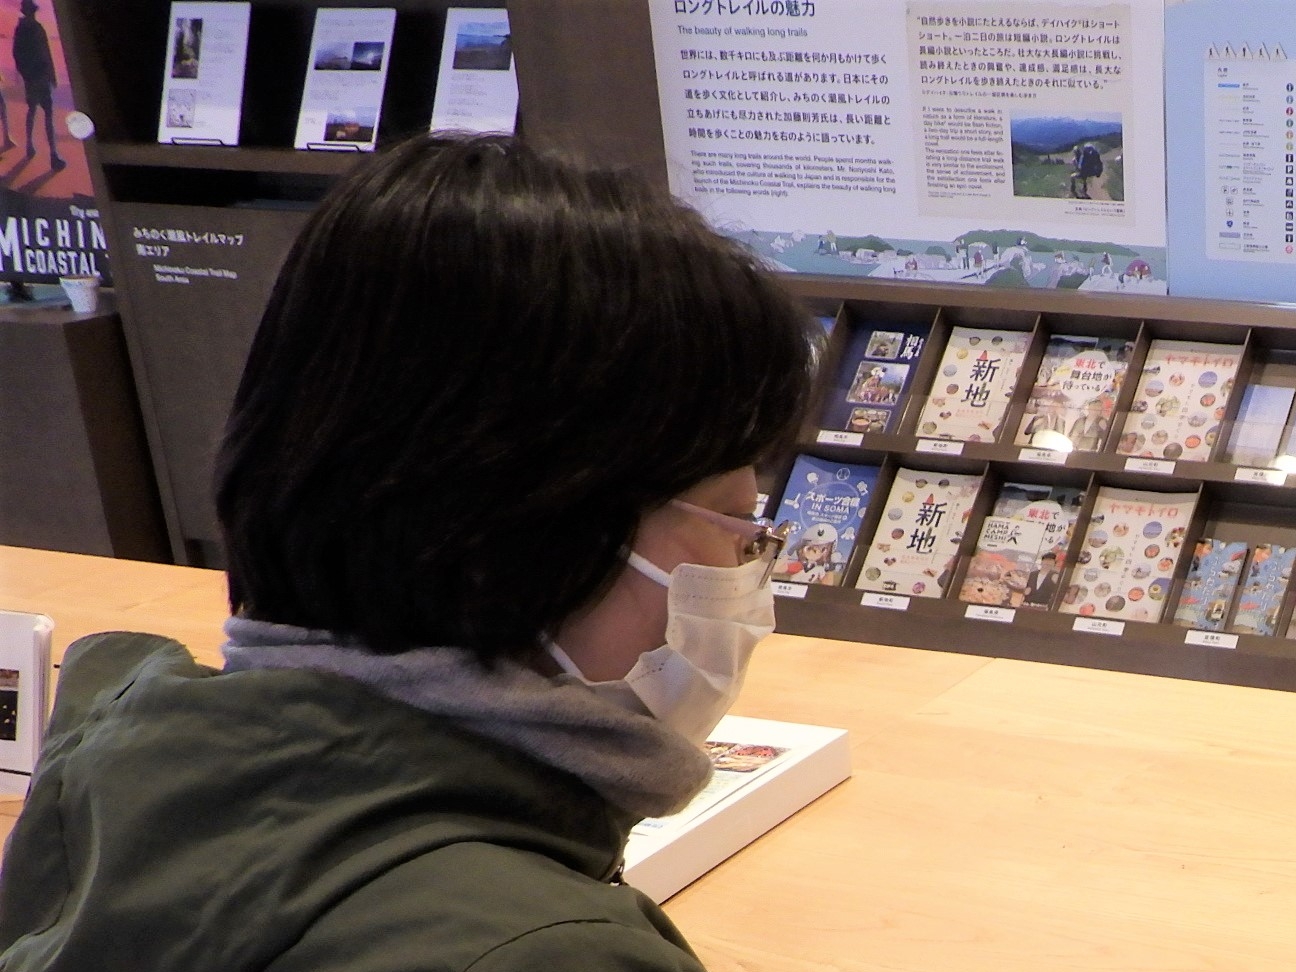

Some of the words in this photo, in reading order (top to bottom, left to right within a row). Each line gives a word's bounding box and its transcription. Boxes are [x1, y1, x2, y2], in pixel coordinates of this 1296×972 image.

[678, 25, 692, 35] The
[695, 26, 721, 36] beauty
[724, 27, 732, 35] of
[735, 27, 765, 37] walking
[768, 28, 785, 38] long
[788, 28, 808, 37] trails
[25, 249, 101, 277] COASTAL
[1075, 358, 1105, 369] 東北で
[961, 350, 1001, 408] 新地
[811, 502, 822, 511] IN
[1028, 508, 1060, 520] 東北で
[906, 493, 948, 555] 新地
